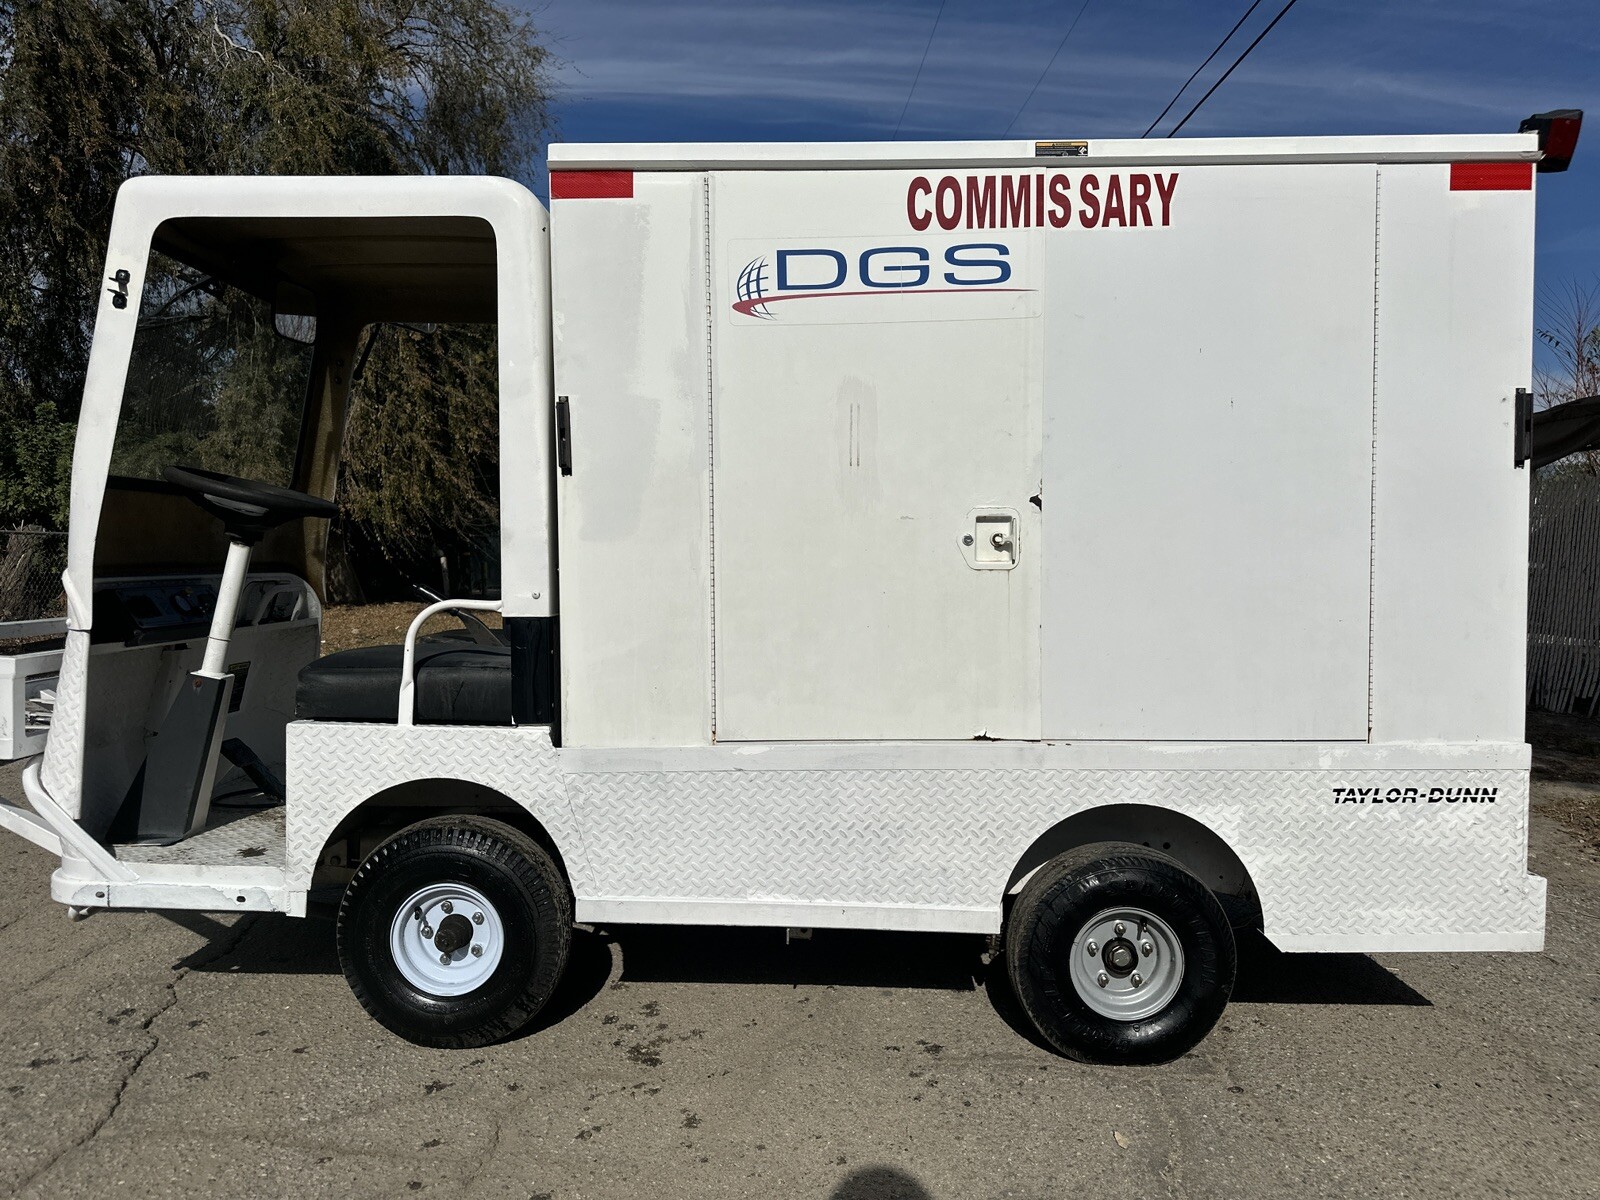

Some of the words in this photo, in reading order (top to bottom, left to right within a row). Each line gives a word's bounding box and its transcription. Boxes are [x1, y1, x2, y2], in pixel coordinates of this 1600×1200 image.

[907, 173, 1179, 231] COMMISSARY
[776, 243, 1011, 291] DGS
[1332, 787, 1498, 804] TAYLOR-DUNN
